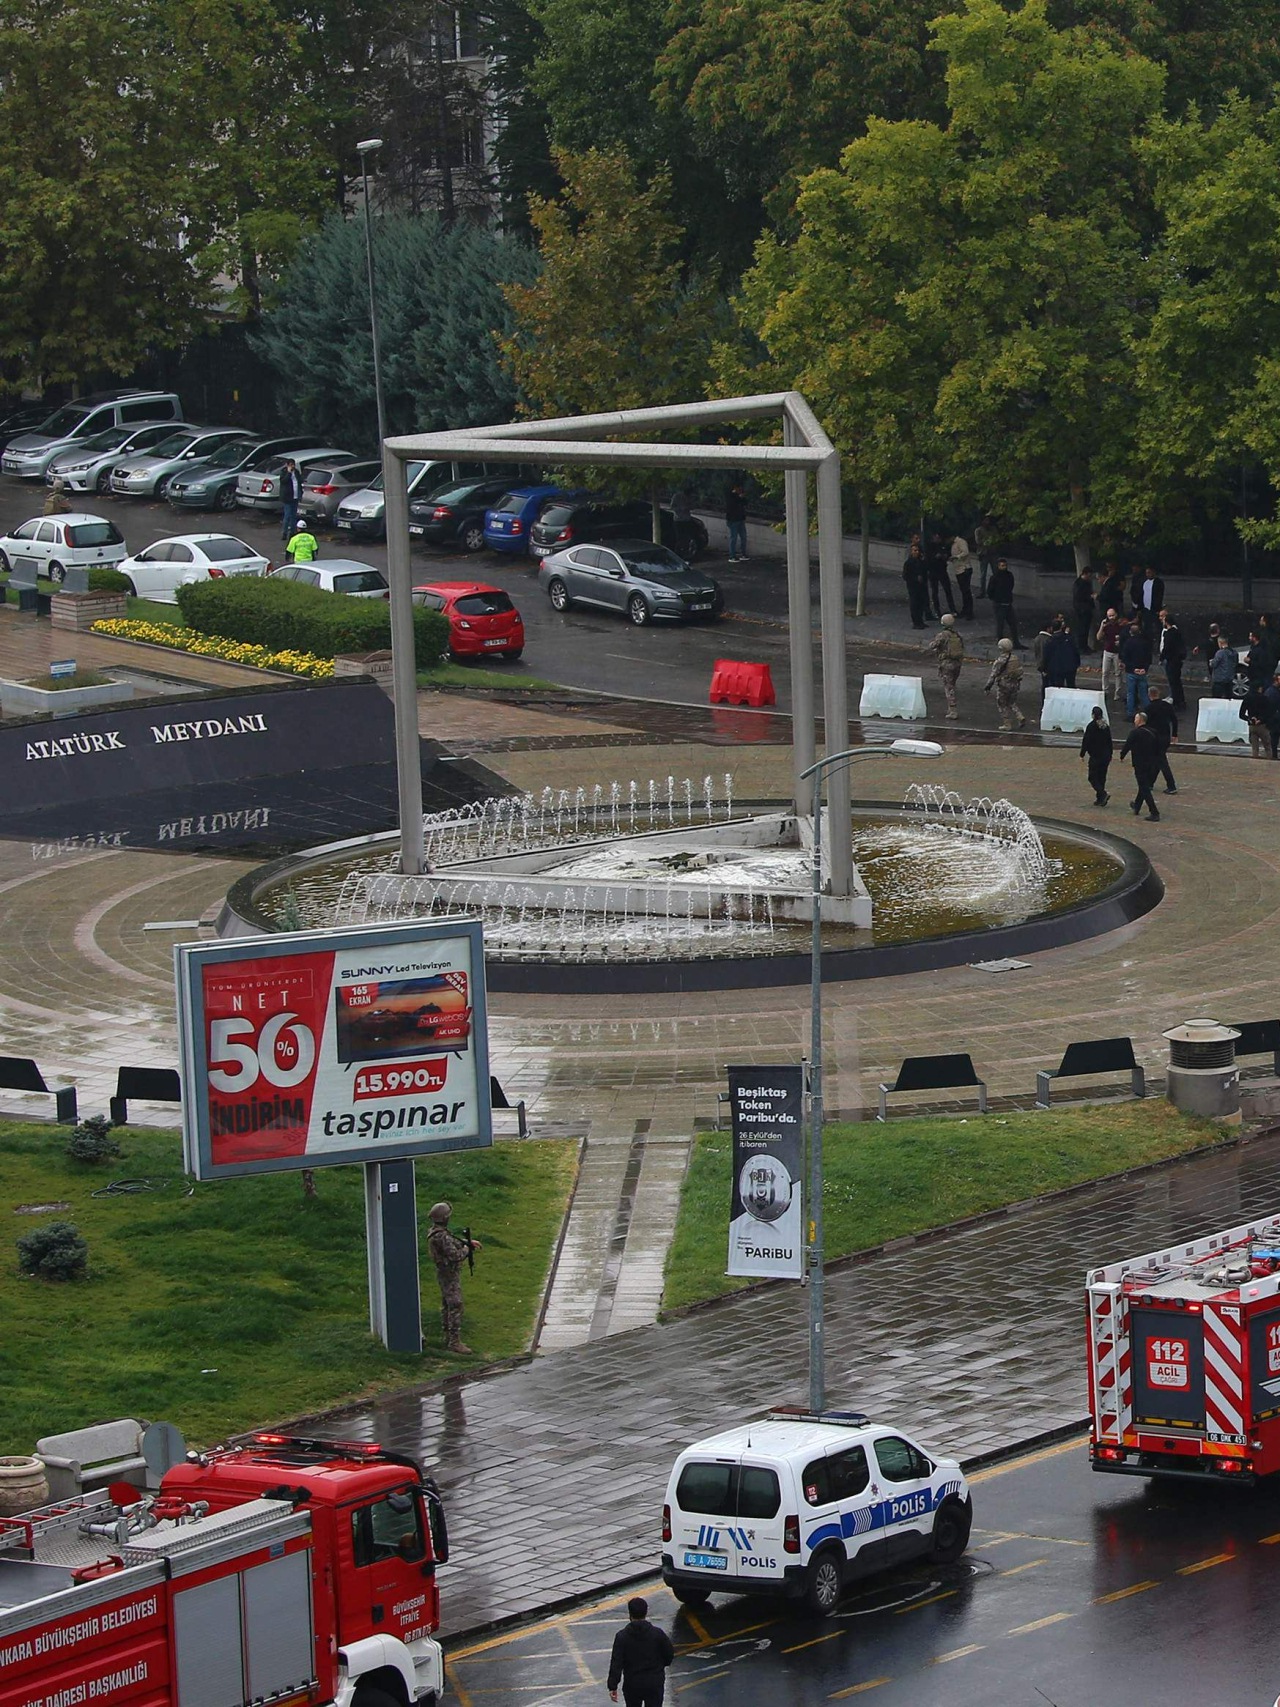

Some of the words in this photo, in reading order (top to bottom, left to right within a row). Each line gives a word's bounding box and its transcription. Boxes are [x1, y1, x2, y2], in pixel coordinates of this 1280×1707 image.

[26, 731, 126, 761] ATATÜRK
[151, 713, 268, 744] MEYDANI
[341, 965, 395, 979] SUNNY
[395, 965, 410, 973] Led
[411, 961, 452, 971] Televizyon
[453, 972, 467, 985] DEV
[351, 985, 368, 996] 165
[445, 974, 466, 994] EKRAN
[232, 990, 289, 1012] NET
[349, 996, 371, 1006] EKRAN
[737, 1086, 787, 1099] Beşiktaş
[738, 1099, 772, 1110] Token
[212, 1094, 304, 1136] İNDİRİM
[322, 1101, 466, 1139] taşpınar
[738, 1112, 797, 1123] Paribu'da.
[1151, 1340, 1185, 1361] 112
[1157, 1365, 1181, 1377] ACİL
[0, 1641, 33, 1667] NKARA
[35, 1617, 100, 1655] BÜYÜKŞEHİR
[101, 1594, 157, 1633] BELEDİYESİ
[46, 1680, 87, 1707] DAİRESİ
[89, 1660, 148, 1697] BAŞKANLIĞI
